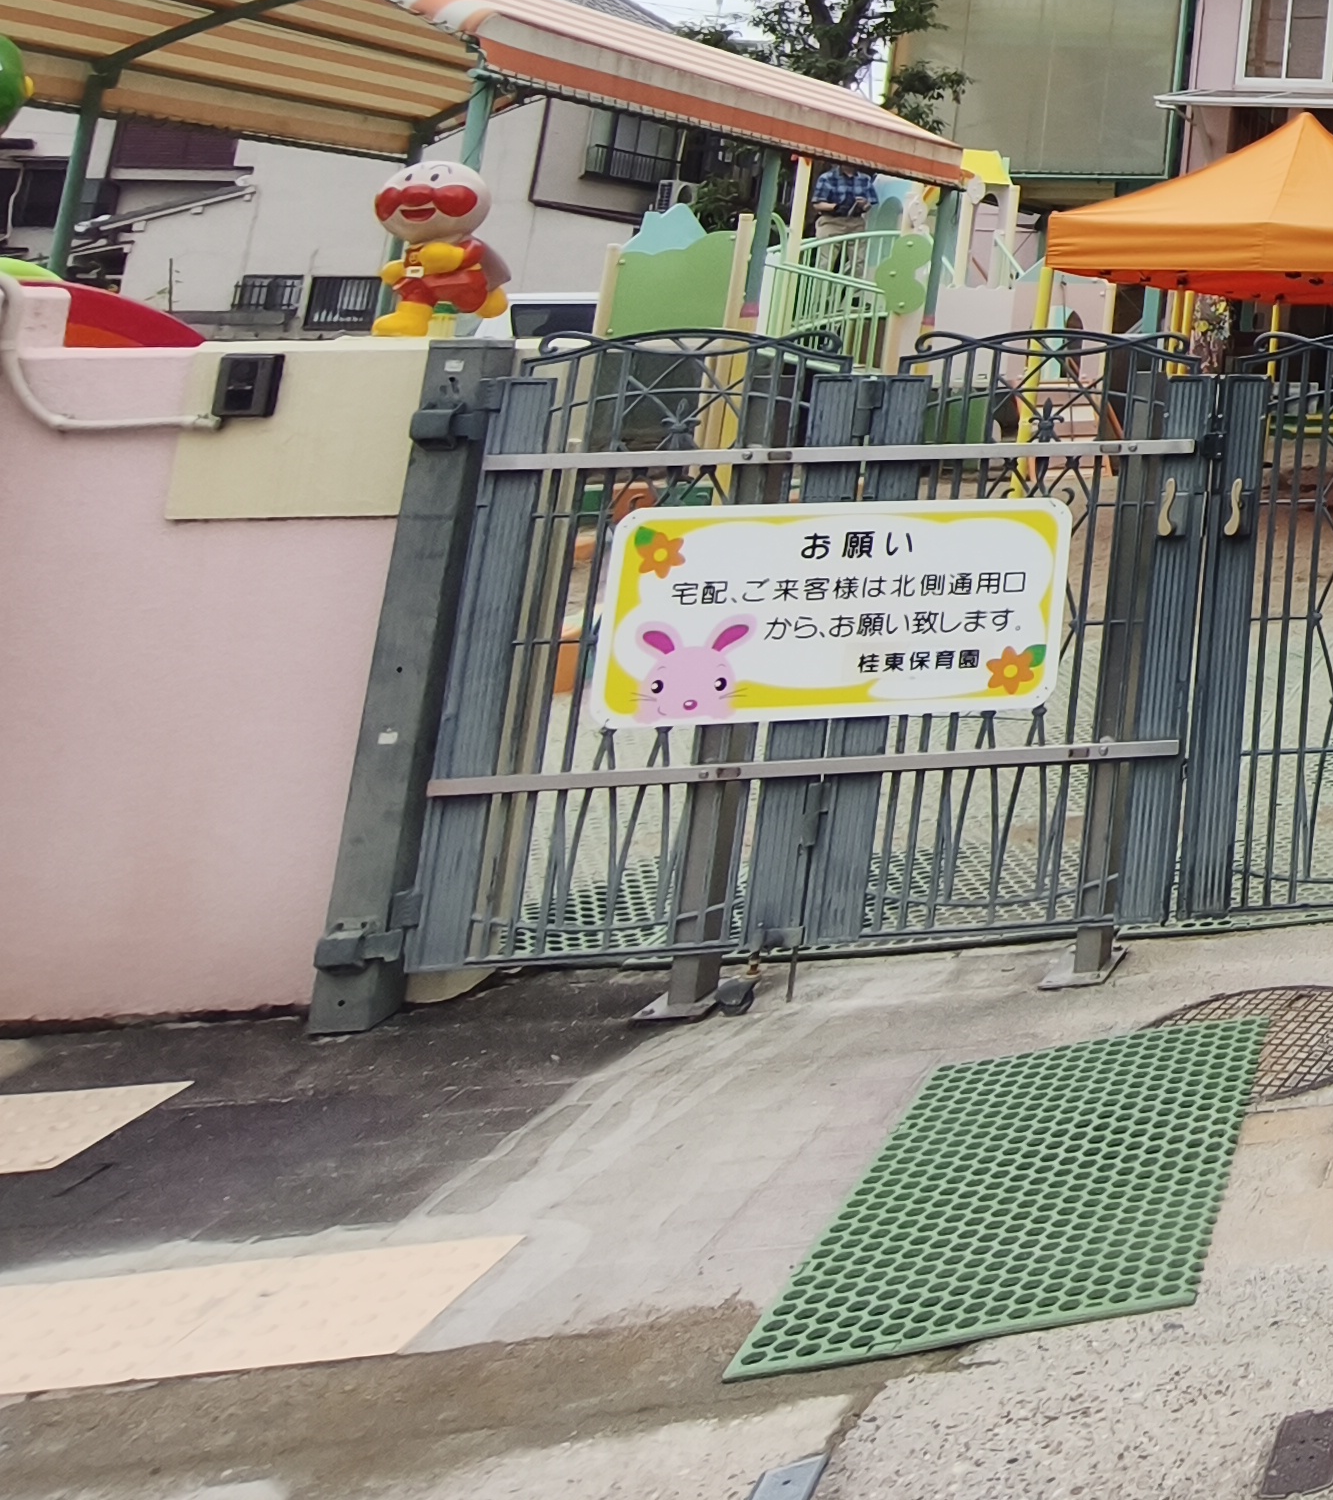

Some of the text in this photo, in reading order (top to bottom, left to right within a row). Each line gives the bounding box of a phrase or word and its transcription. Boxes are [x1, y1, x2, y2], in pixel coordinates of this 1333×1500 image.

[800, 530, 914, 560] お願い
[671, 571, 1027, 606] 宅配、ご来客様は北側通用口
[764, 608, 1022, 641] から、お願い致します。
[857, 649, 980, 674] 桂東保育園
